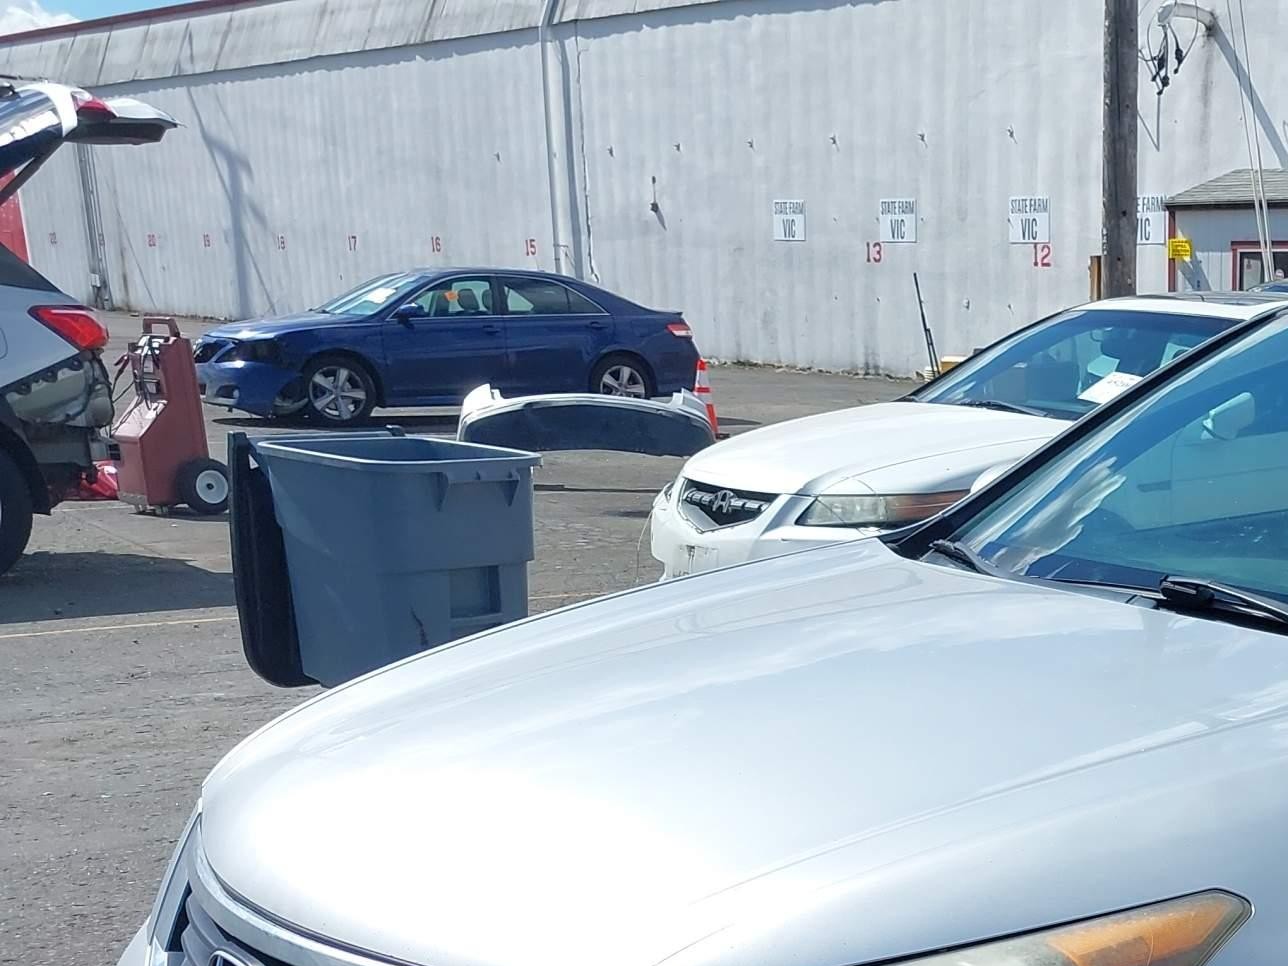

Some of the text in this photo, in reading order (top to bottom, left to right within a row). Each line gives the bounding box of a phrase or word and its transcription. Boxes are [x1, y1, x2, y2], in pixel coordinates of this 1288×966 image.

[774, 201, 804, 215] STATE FARM
[881, 200, 914, 215] STATE FARM
[1011, 198, 1048, 214] STATE FARM
[782, 218, 796, 238] VIC
[890, 218, 905, 239] VIC
[1021, 217, 1038, 241] VIC
[348, 235, 357, 251] 17
[431, 236, 441, 253] 16
[525, 239, 537, 256] 15
[866, 242, 882, 263] 13
[1034, 243, 1052, 267] 12
